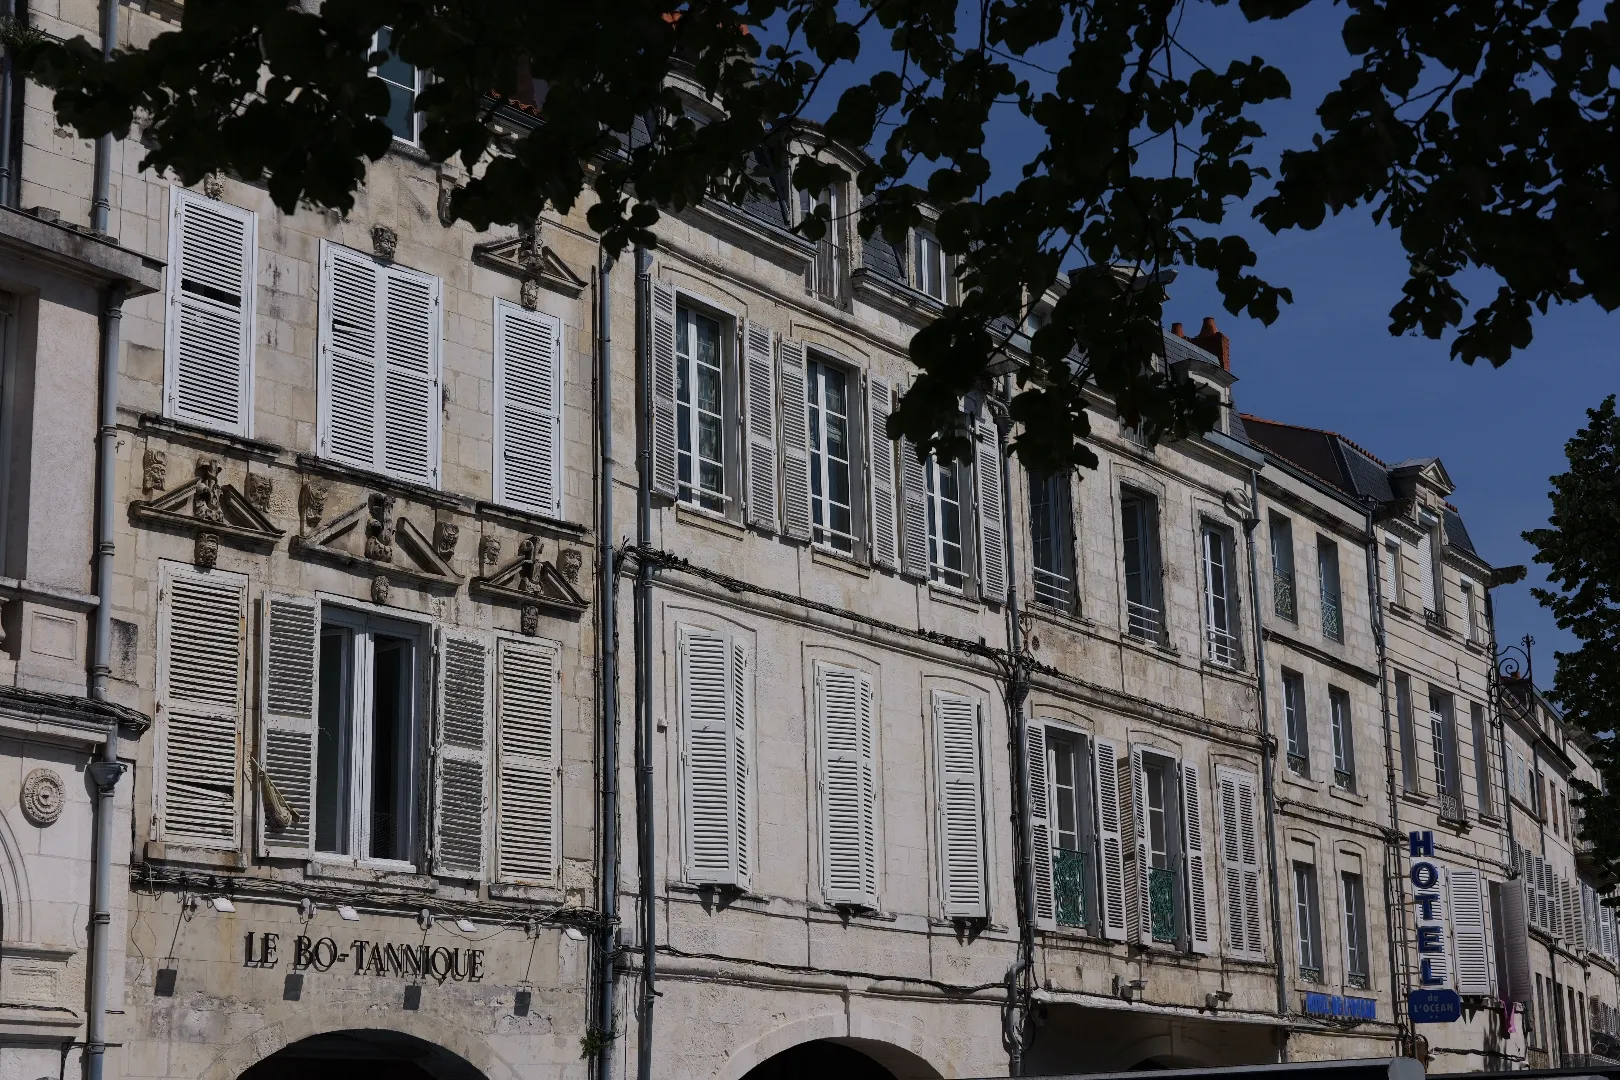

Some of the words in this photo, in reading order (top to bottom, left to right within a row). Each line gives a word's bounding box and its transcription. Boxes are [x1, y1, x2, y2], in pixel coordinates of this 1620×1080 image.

[1409, 831, 1444, 986] HOTEL
[246, 931, 279, 965] LE
[296, 935, 485, 984] BO-TANNIQUE
[1414, 1003, 1453, 1013] L'OCEAN
[1427, 993, 1439, 1002] de
